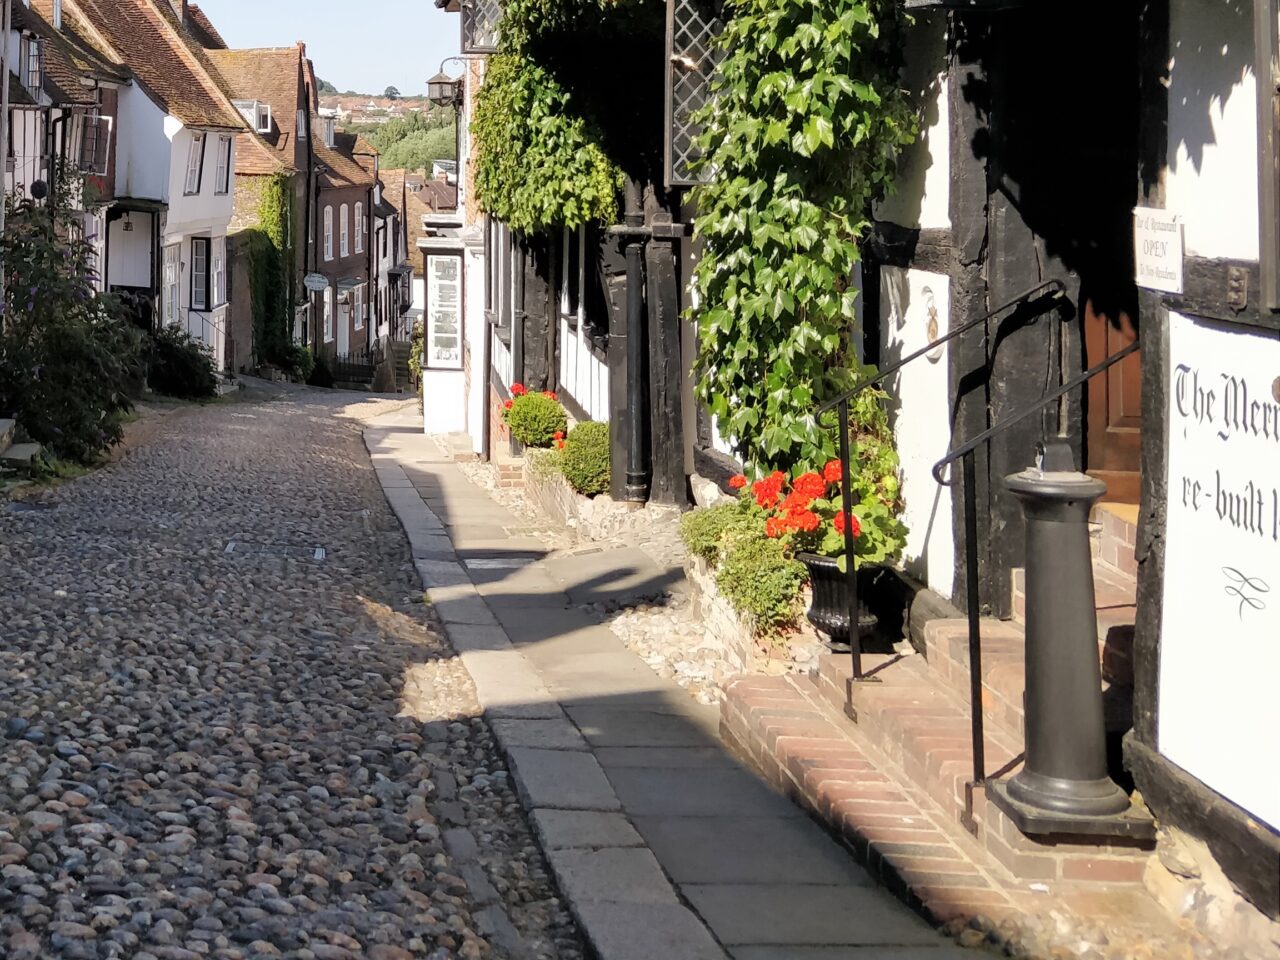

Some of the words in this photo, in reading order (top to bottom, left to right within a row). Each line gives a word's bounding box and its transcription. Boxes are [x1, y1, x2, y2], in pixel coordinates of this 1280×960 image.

[1143, 239, 1168, 258] OPEN
[1174, 364, 1216, 428] The
[1183, 469, 1264, 537] re-built
